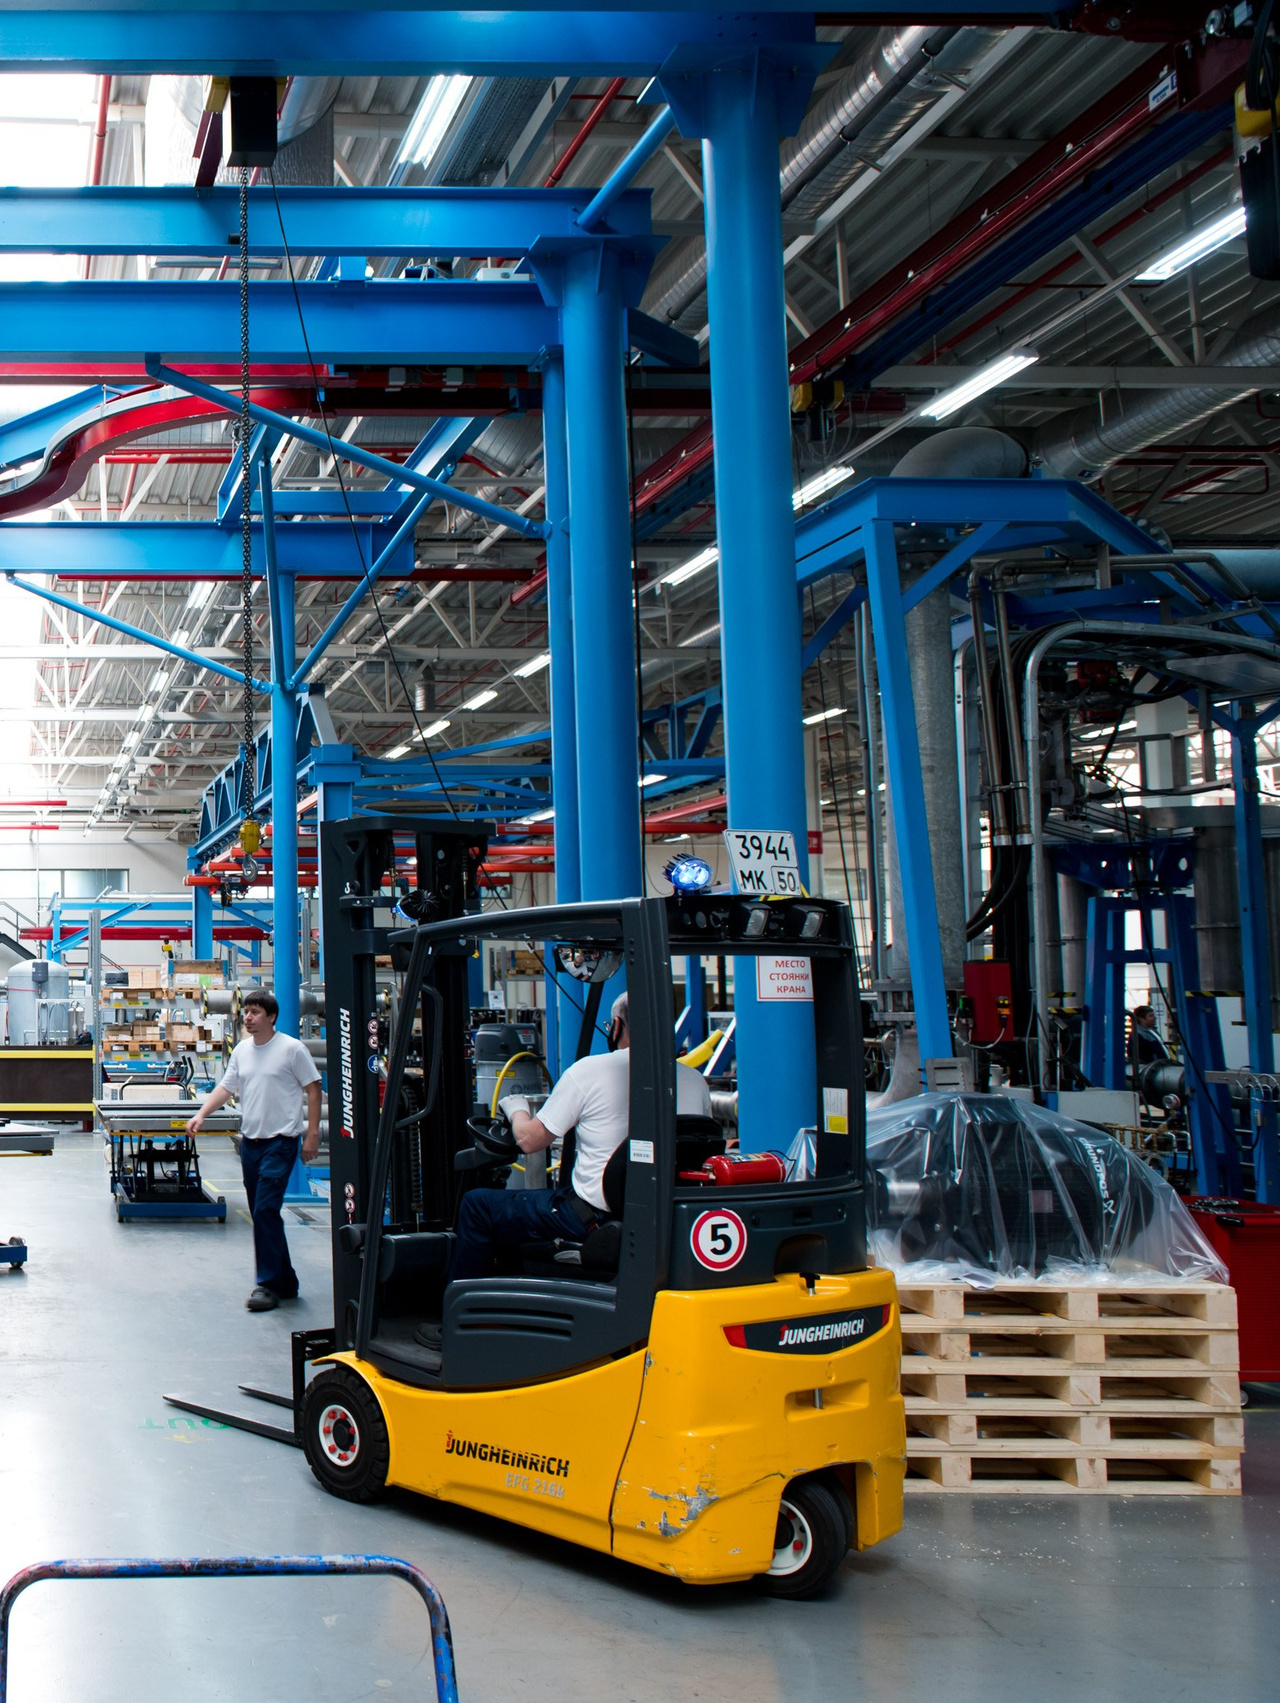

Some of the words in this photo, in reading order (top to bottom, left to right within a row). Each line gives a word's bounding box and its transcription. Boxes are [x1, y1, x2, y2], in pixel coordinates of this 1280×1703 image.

[735, 834, 790, 861] 3944
[777, 871, 797, 892] 50
[775, 960, 806, 968] МЕСТО
[769, 972, 810, 981] СТОЯНКИ
[776, 985, 807, 994] КРАНА
[339, 1007, 355, 1139] JUNGHEINRICH
[709, 1222, 733, 1256] 5
[779, 1319, 864, 1346] JUNGHEINRICH
[445, 1438, 570, 1478] JUNGHEINRICH
[505, 1472, 530, 1491] EFG
